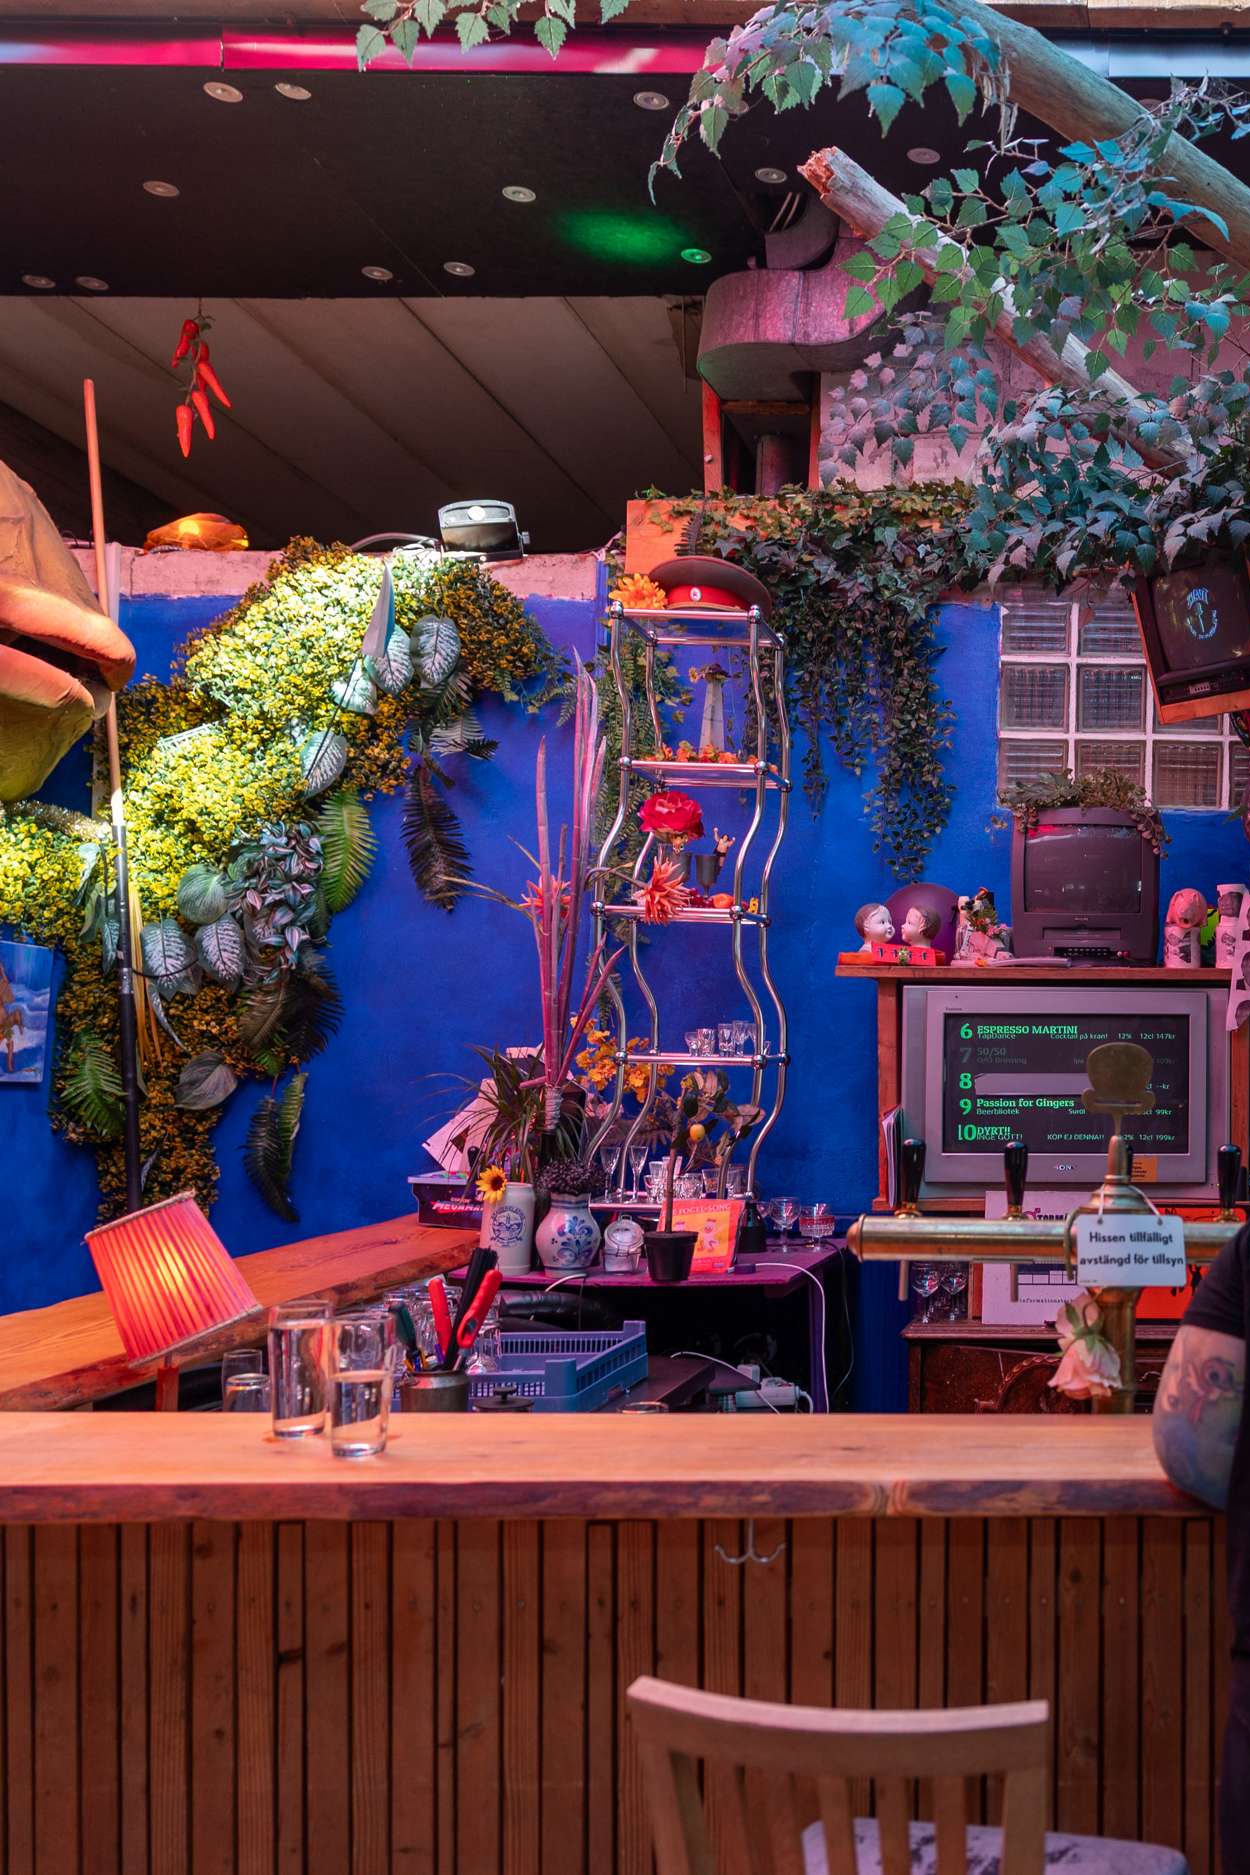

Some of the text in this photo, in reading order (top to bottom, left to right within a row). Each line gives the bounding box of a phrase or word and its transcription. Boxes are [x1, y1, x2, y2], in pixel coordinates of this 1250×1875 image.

[960, 1023, 973, 1040] 6
[976, 1025, 1079, 1035] ESPRESSO MARTINI
[960, 1047, 972, 1063] 7
[959, 1072, 972, 1089] 8
[959, 1098, 972, 1115] 9
[976, 1098, 1075, 1110] Passion for Gingers
[957, 1123, 977, 1141] 10
[1089, 1231, 1173, 1246] Hissen tillfälligt
[1080, 1252, 1184, 1268] avstängd för tillsyn
